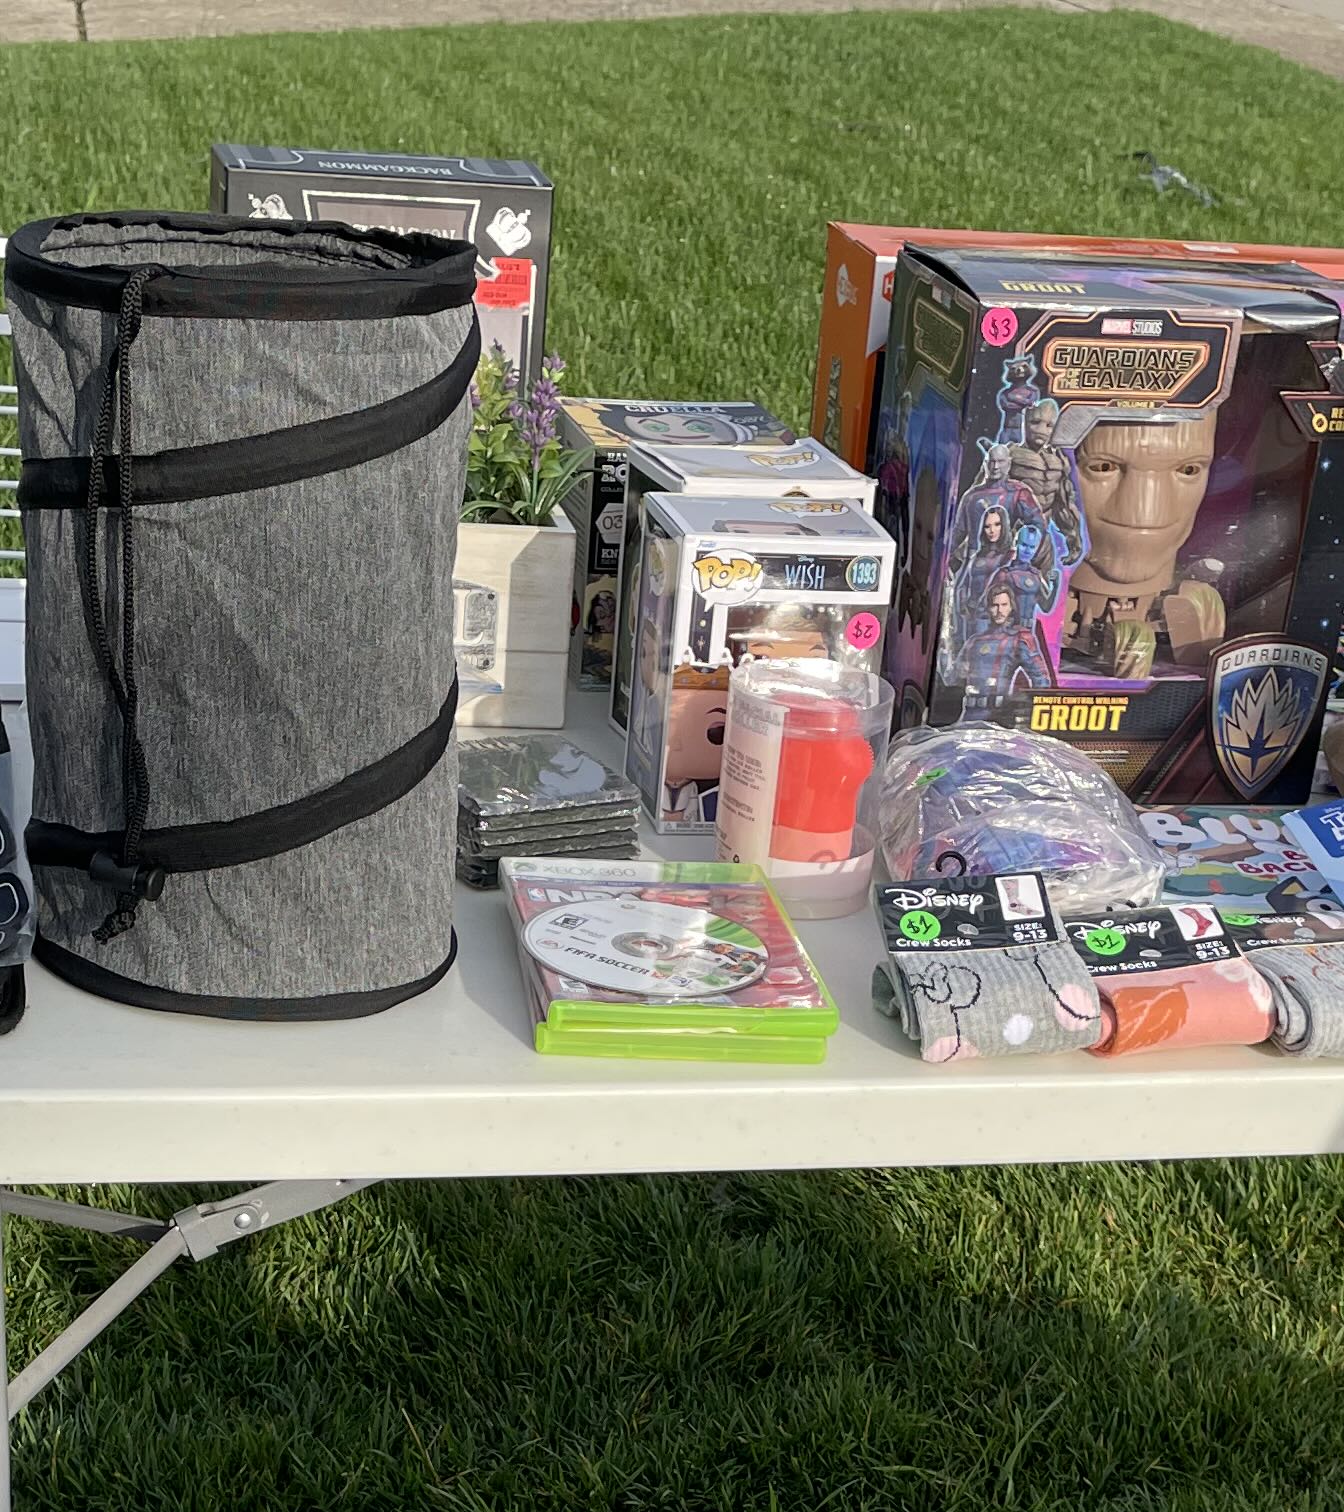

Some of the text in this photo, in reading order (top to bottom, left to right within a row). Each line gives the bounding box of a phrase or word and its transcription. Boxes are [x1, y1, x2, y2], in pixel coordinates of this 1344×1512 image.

[318, 159, 454, 177] BACKGAMMON
[999, 280, 1088, 295] GROOT
[989, 317, 1012, 340] $3
[1132, 319, 1163, 336] STUDIOS
[1055, 346, 1197, 370] GUARDIANS
[1067, 368, 1081, 378] OF
[1080, 370, 1186, 390] GALAXY
[1059, 378, 1080, 390] THE
[692, 555, 763, 592] POP!
[784, 563, 826, 590] WISH
[852, 564, 877, 585] 1393
[1220, 647, 1323, 672] GUARDIANS
[1030, 705, 1127, 731] GROOT
[1139, 812, 1298, 847] BLU
[543, 864, 636, 878] XBOX 360
[906, 915, 934, 935] $1
[896, 937, 972, 948] Crew Socks
[1013, 931, 1048, 942] 9-13
[1246, 939, 1278, 947] Crew
[564, 947, 597, 960] FIFA
[596, 956, 650, 975] SOCCER
[1195, 948, 1231, 960] 9-13
[1086, 960, 1158, 973] Crew Socks
